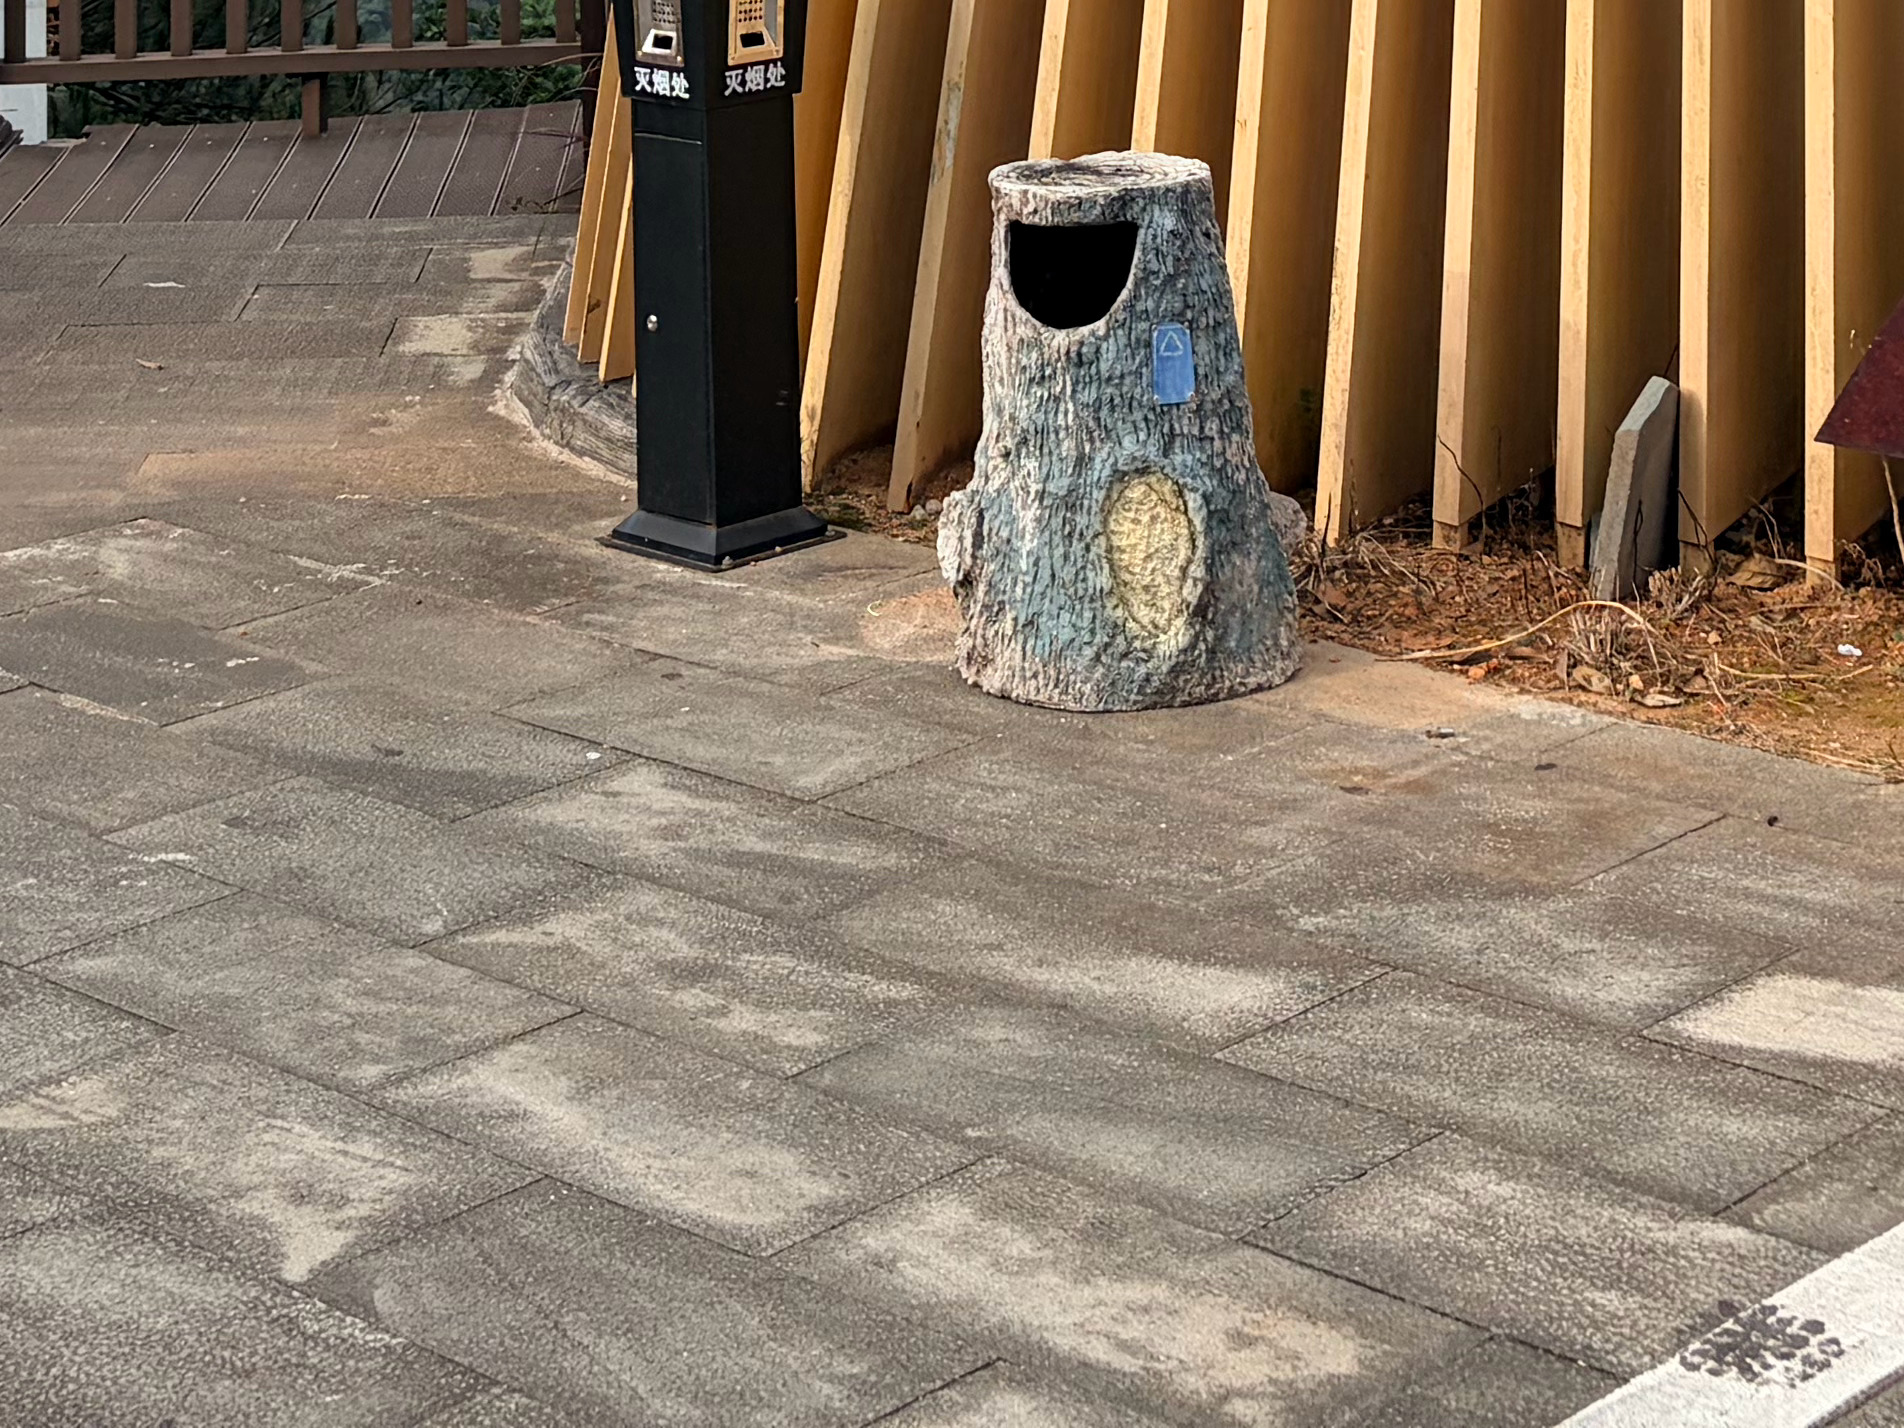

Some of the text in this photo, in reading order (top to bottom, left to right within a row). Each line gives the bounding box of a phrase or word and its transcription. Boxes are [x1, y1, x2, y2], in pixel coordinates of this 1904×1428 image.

[633, 66, 690, 99] 灭烟处
[724, 61, 787, 96] 灭烟处
